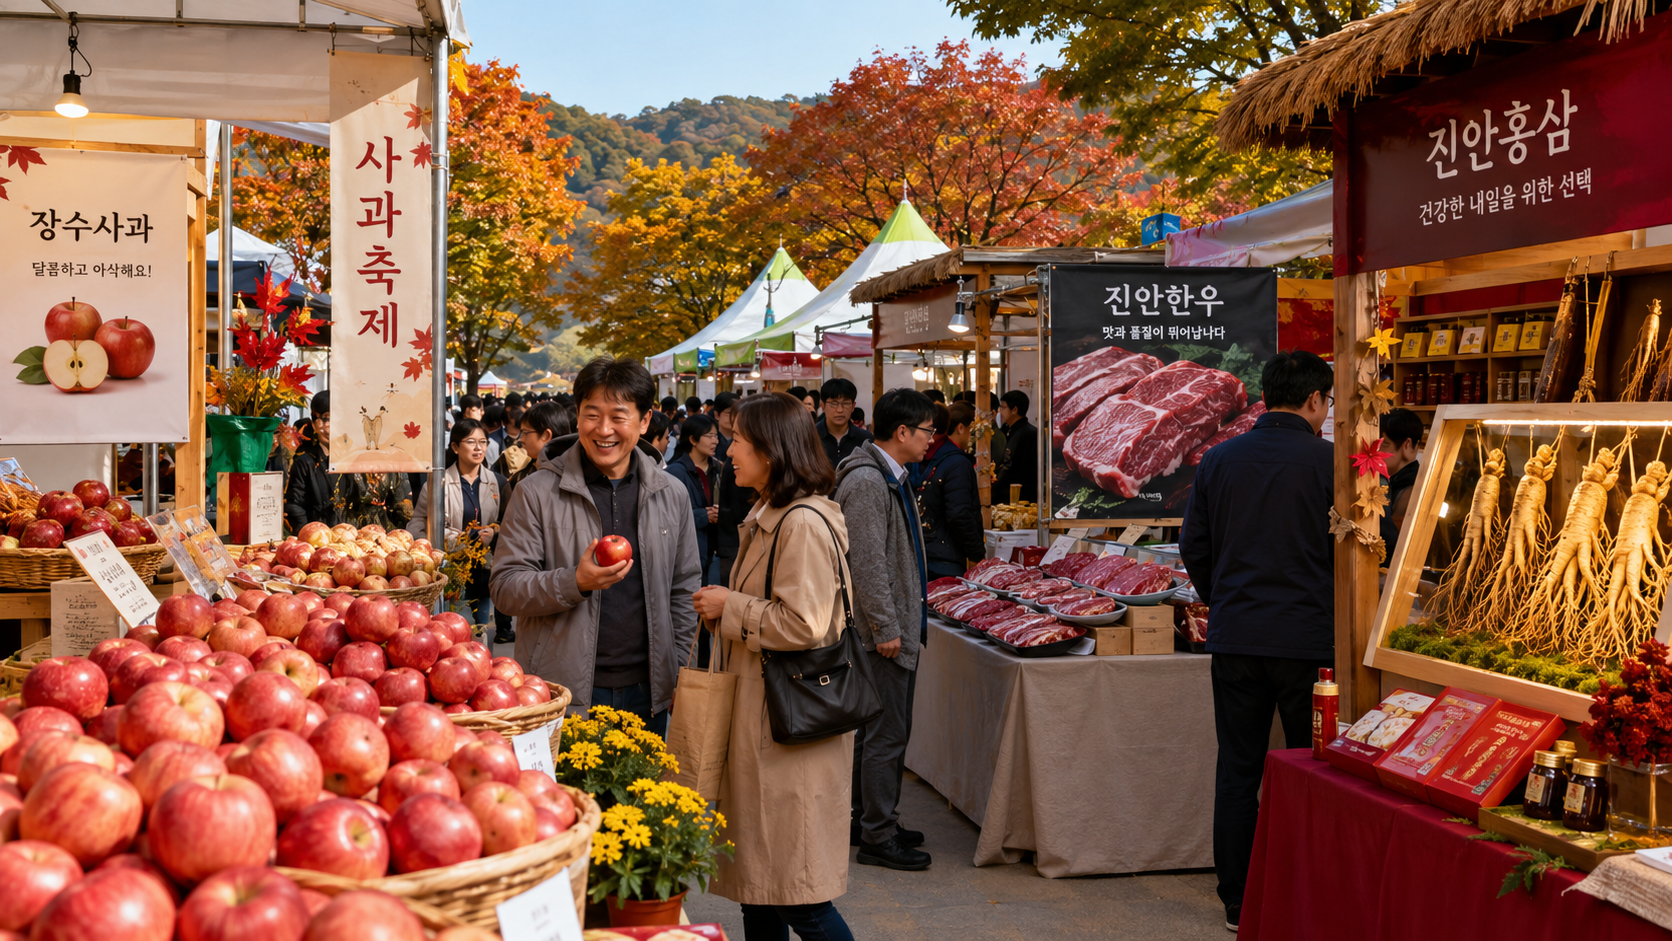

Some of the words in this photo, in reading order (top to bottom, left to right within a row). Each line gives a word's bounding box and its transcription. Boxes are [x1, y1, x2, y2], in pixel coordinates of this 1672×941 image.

[1426, 88, 1579, 180] 진안홍삼
[1419, 194, 1465, 226] 건강한
[1470, 184, 1517, 215] 내일을
[1521, 175, 1554, 206] 위한
[1558, 167, 1592, 199] 선택
[29, 208, 154, 244] 장수사과
[355, 135, 403, 349] 사과축제
[93, 262, 152, 279] 아삭해요!
[1103, 283, 1225, 318] 진안한우
[1102, 325, 1127, 340] 맛과
